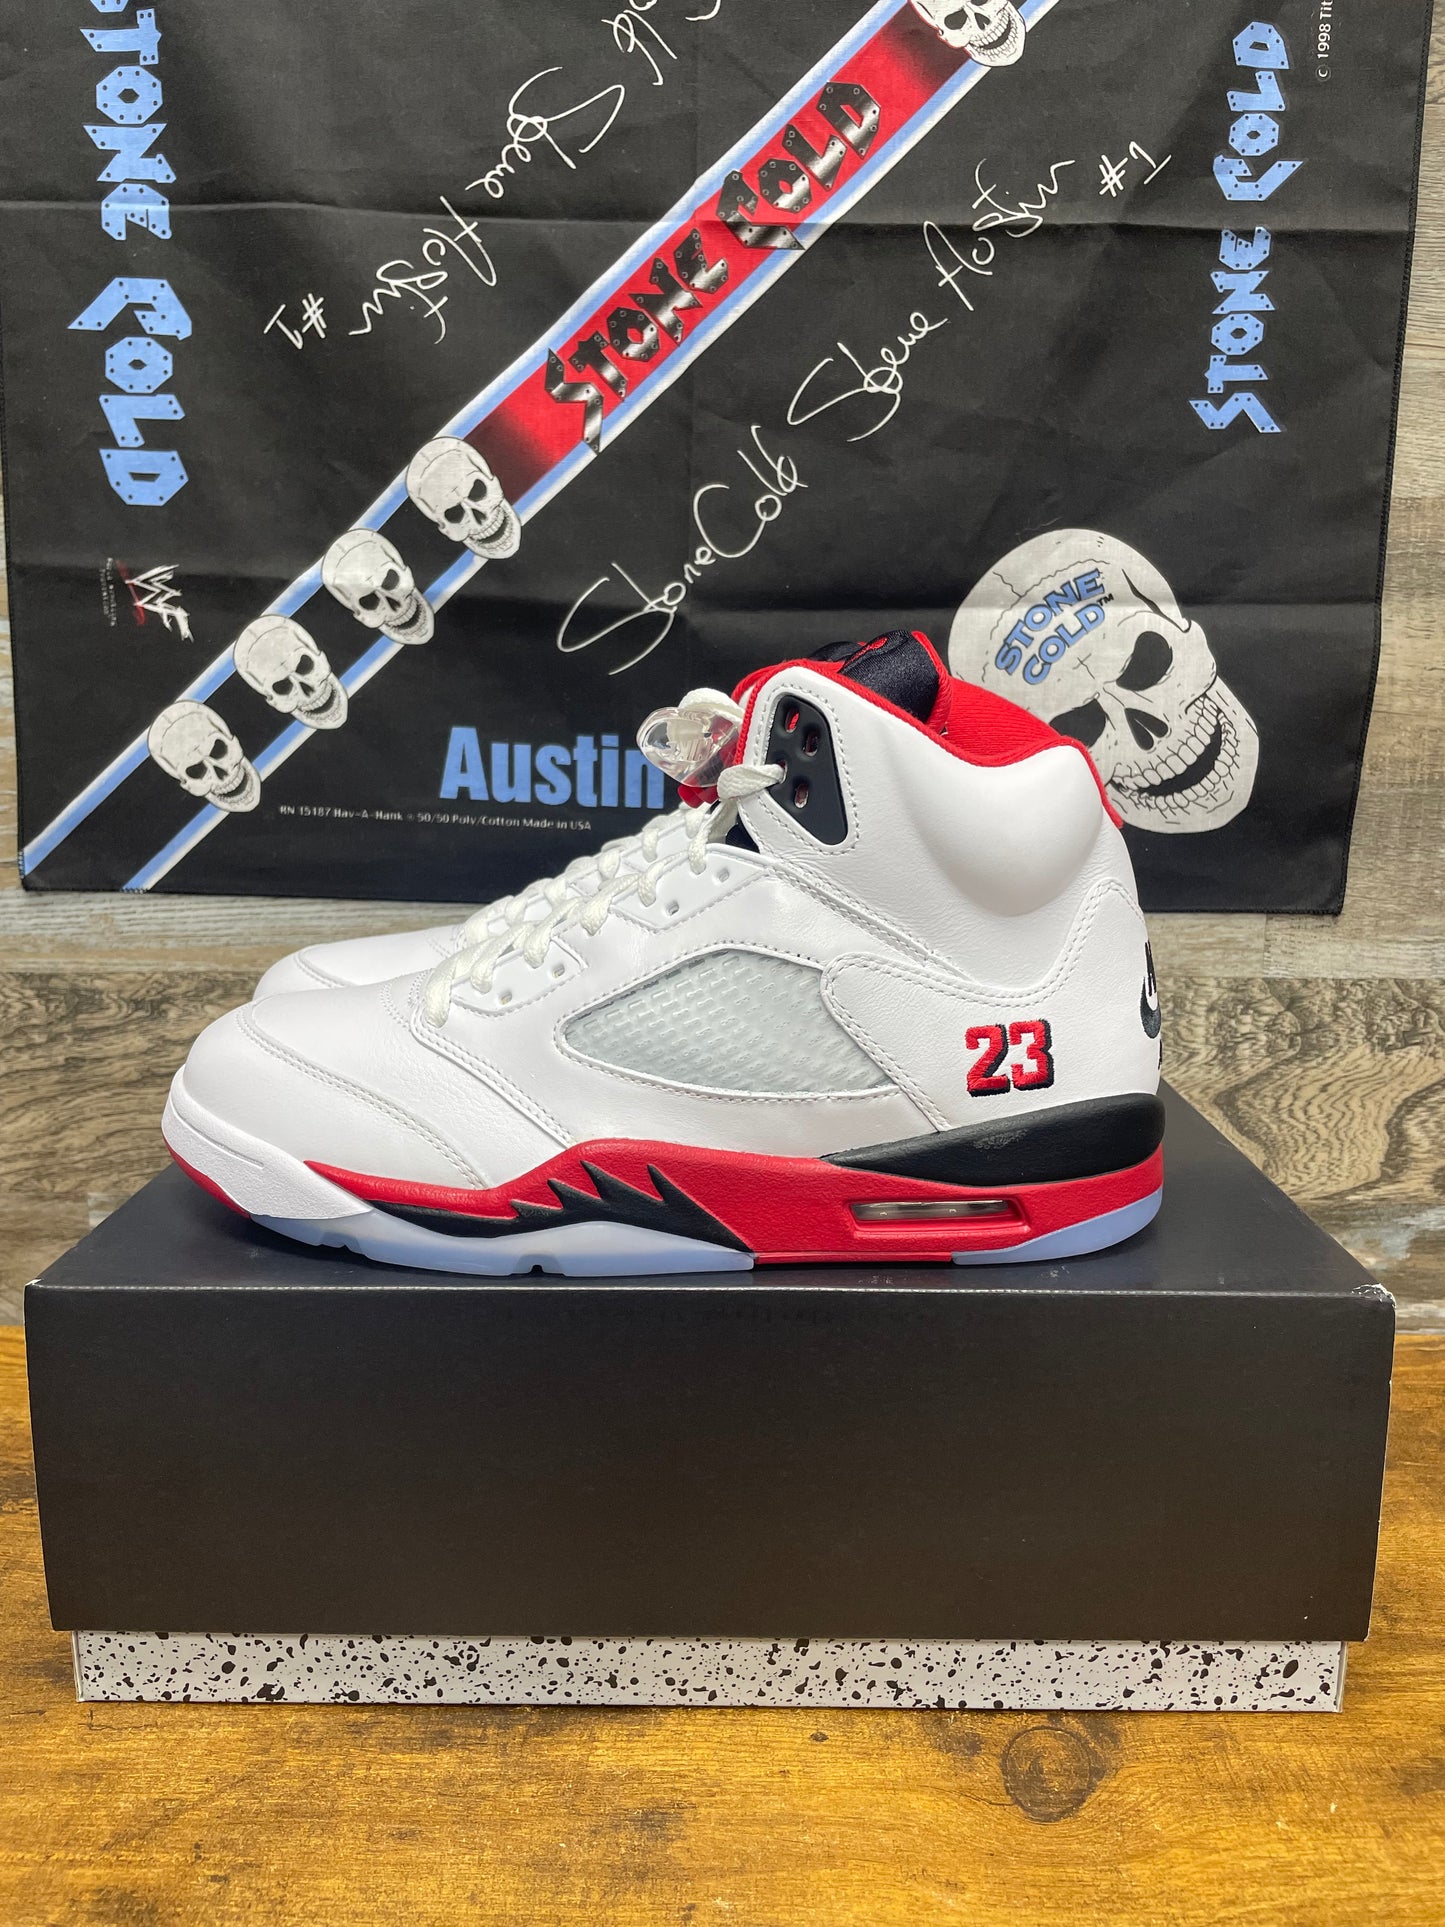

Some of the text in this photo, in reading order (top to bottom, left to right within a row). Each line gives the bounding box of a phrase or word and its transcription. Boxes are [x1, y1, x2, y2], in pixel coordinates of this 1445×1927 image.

[1317, 23, 1332, 59] 1998
[67, 0, 193, 507] TONE COLD
[544, 81, 882, 455] STONE COLD
[1188, 21, 1304, 433] STONE COLD
[994, 568, 1106, 676] STONE
[1022, 603, 1106, 686] COLD
[439, 726, 664, 809] Austin
[279, 804, 296, 816] RN
[299, 805, 331, 817] 15187
[417, 812, 450, 824] 50/50
[452, 813, 520, 828] Poly/Cotton
[522, 816, 554, 828] Made
[556, 818, 568, 829] in
[569, 819, 592, 831] USA
[964, 1018, 1055, 1098] 23
